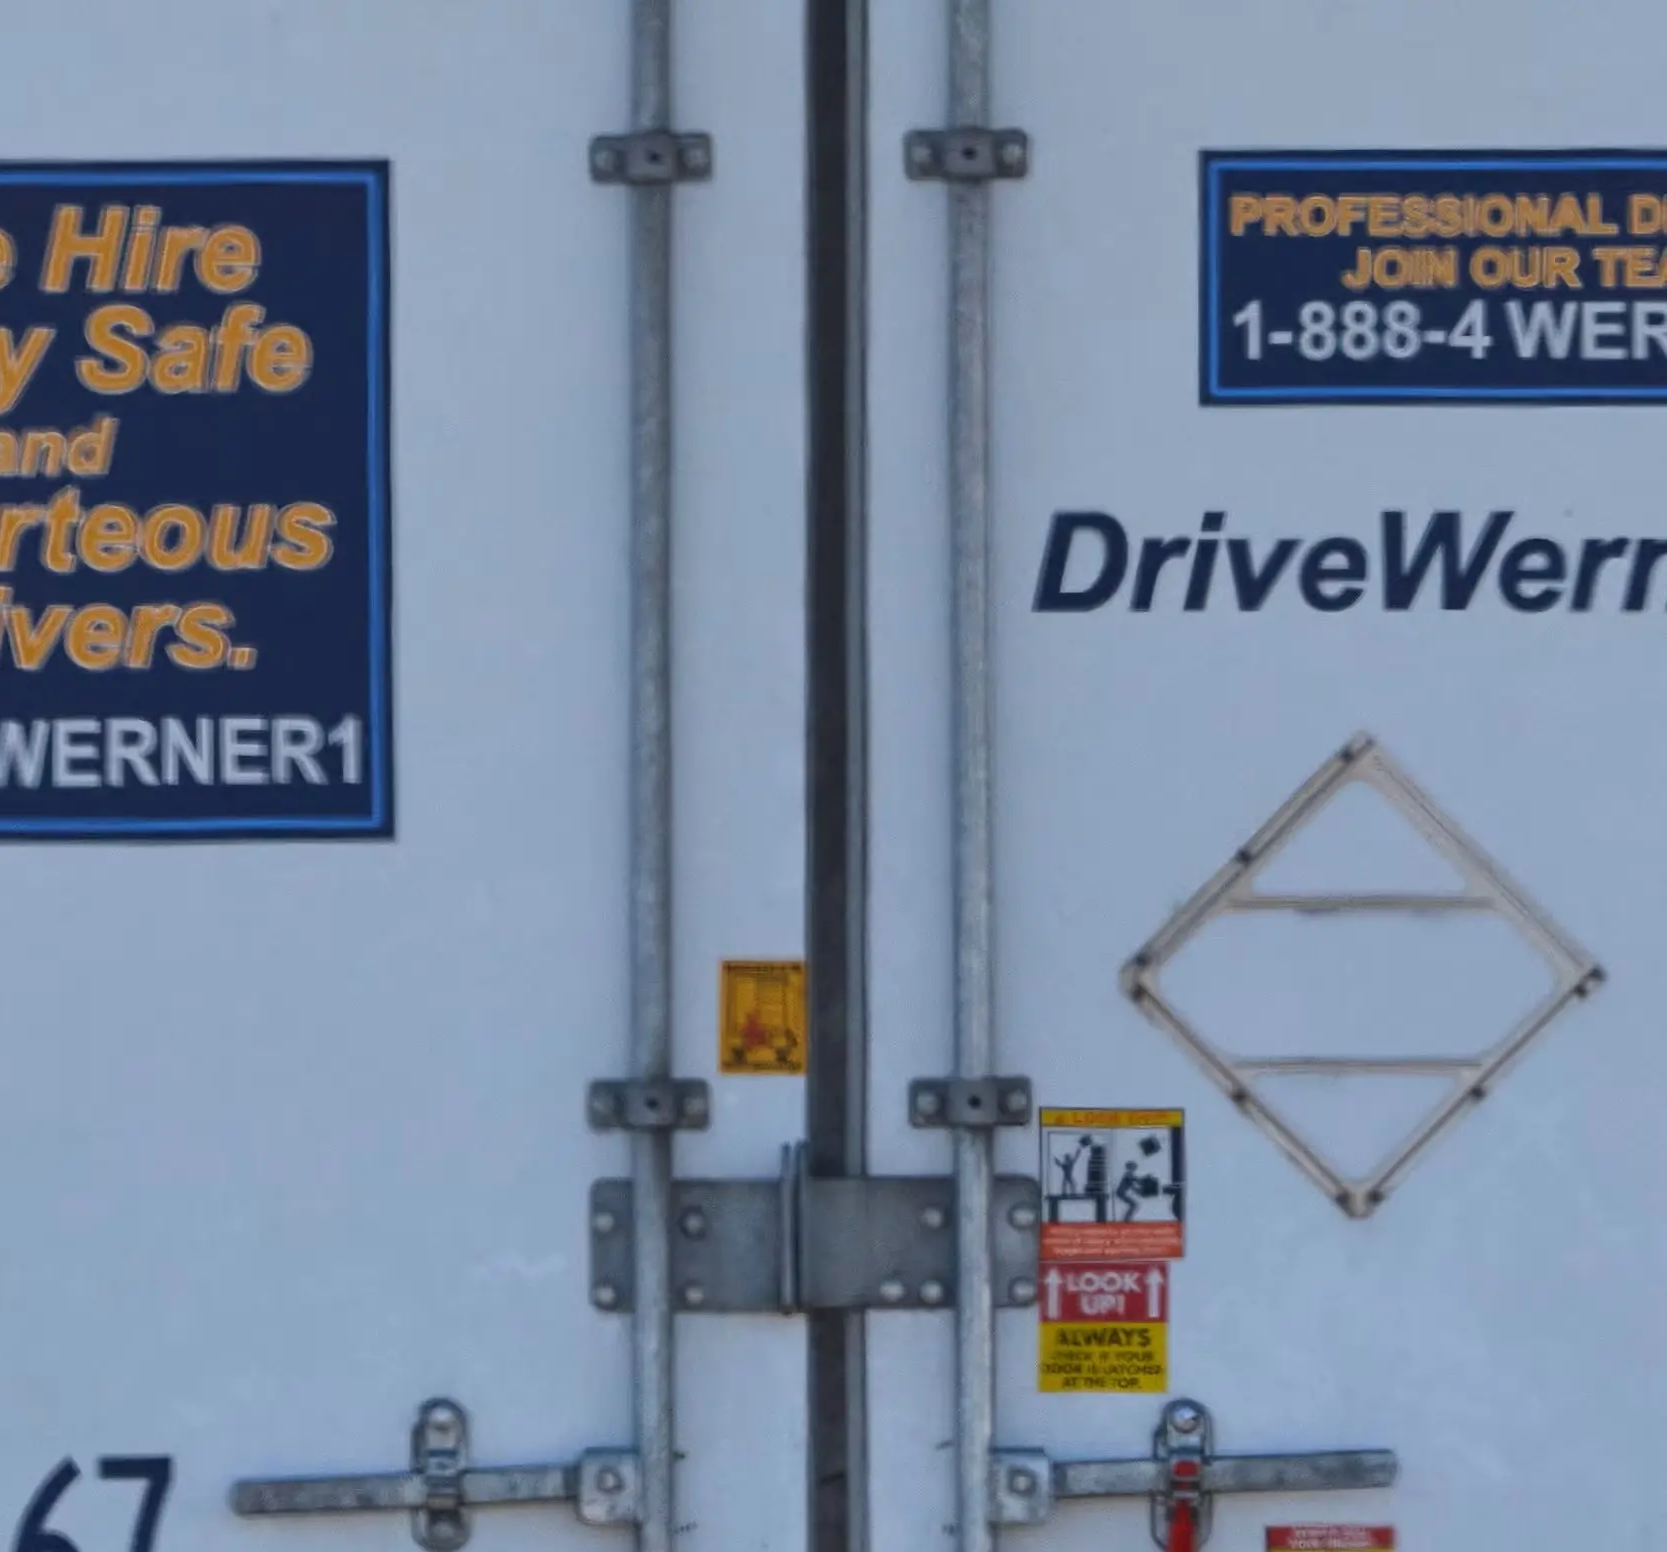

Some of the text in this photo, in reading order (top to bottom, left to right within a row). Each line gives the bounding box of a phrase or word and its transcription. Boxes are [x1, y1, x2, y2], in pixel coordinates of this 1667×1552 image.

[1229, 193, 1667, 238] PROFESSIONAL D
[40, 203, 262, 293] Hire
[1341, 245, 1667, 289] JOIN OUR TE
[77, 302, 313, 394] Safe
[1232, 299, 1493, 360] 1-888-4
[1064, 1271, 1143, 1294] LOOK
[1080, 1294, 1127, 1315] UP!
[1056, 1327, 1152, 1348] ALWAYS
